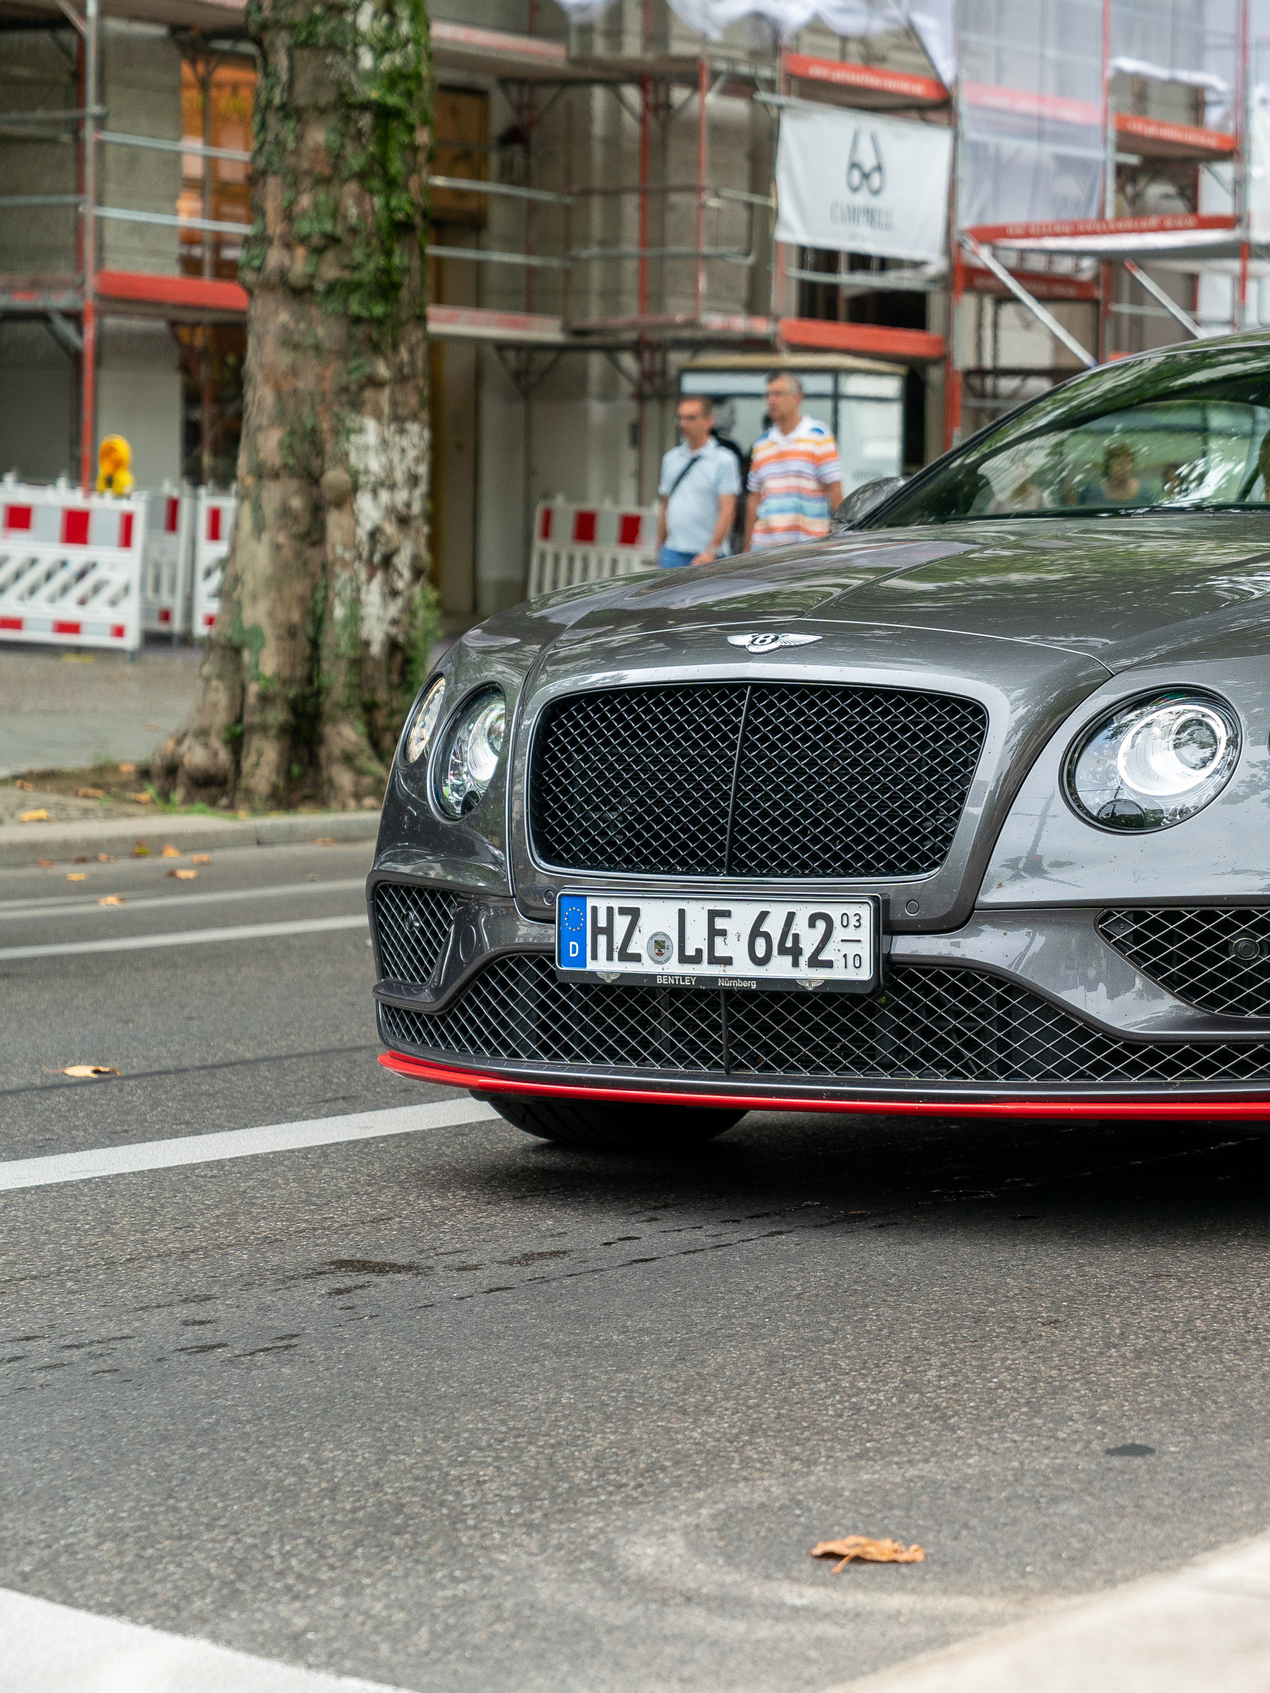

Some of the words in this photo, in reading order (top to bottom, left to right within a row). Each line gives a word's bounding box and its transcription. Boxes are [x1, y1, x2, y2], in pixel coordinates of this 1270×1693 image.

[829, 202, 893, 231] CAMPBELL
[840, 912, 862, 928] 03
[590, 905, 642, 962] HZ
[677, 908, 733, 965] LE
[747, 910, 835, 969] 642
[569, 941, 579, 957] D
[842, 953, 862, 969] 10
[656, 975, 696, 986] BENTLEY
[717, 977, 757, 990] Nürnberg
